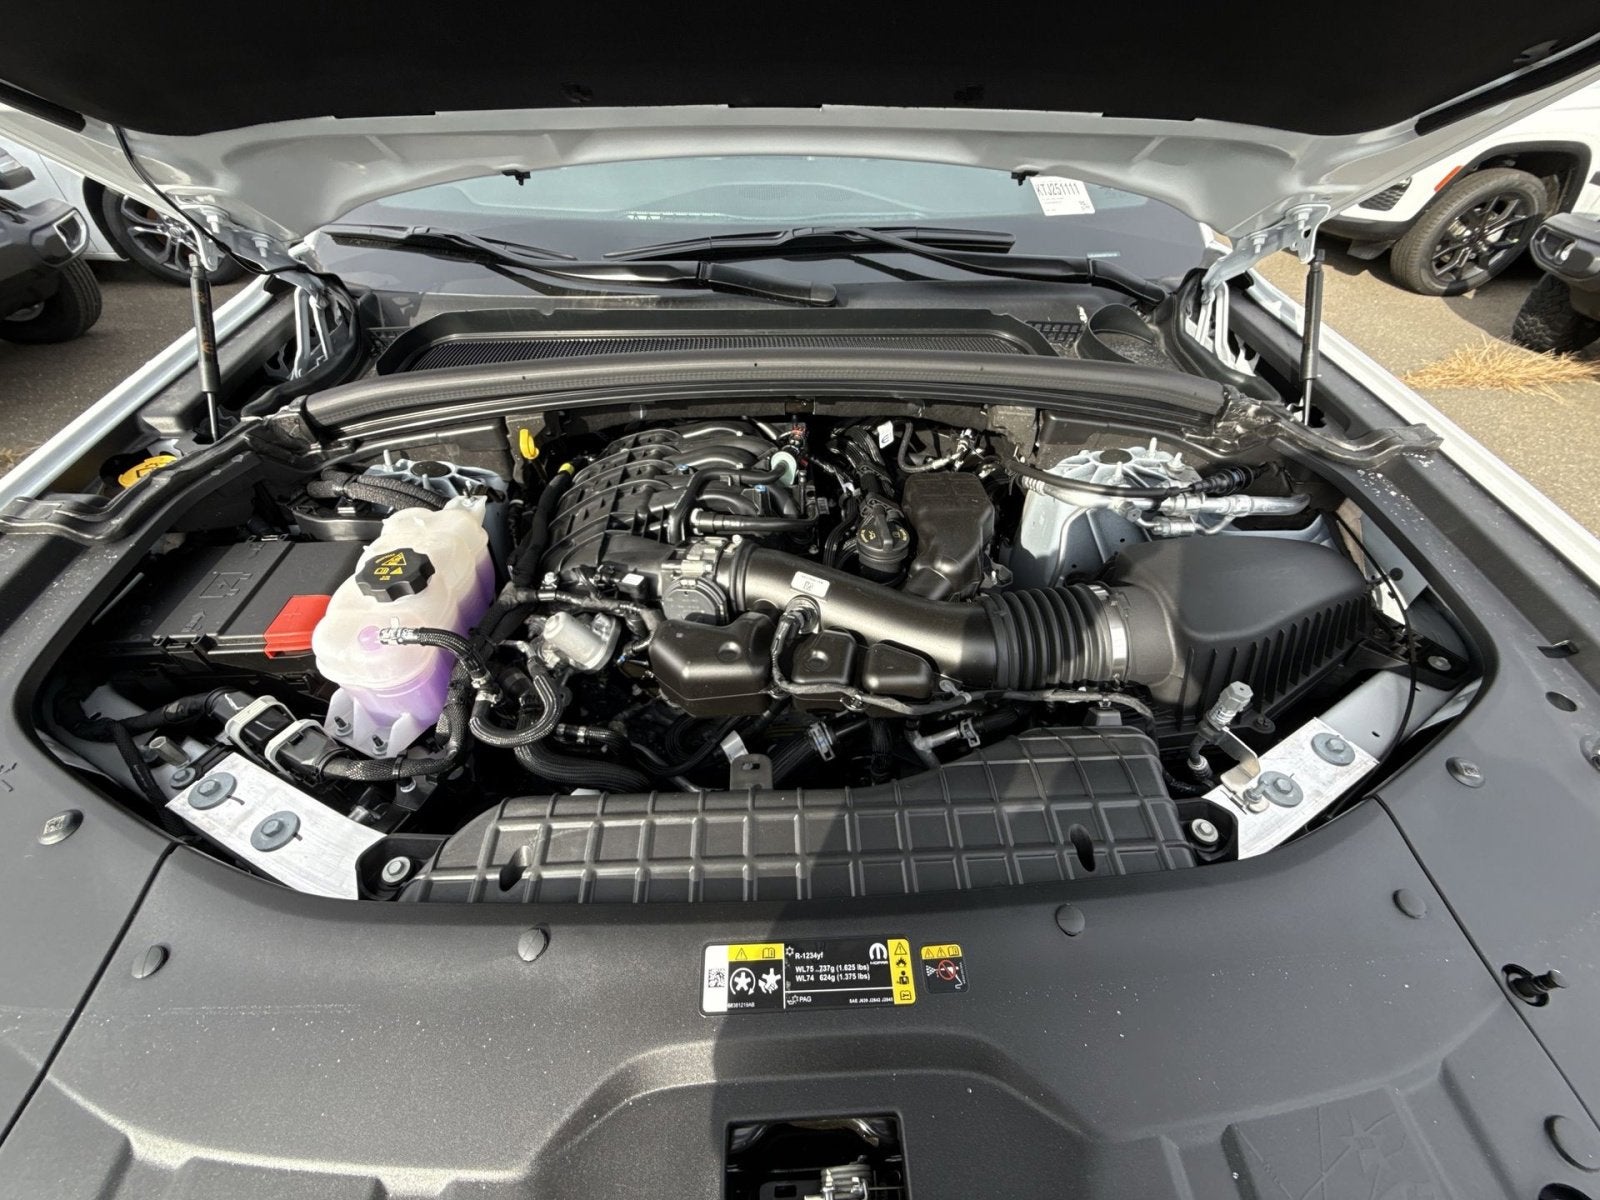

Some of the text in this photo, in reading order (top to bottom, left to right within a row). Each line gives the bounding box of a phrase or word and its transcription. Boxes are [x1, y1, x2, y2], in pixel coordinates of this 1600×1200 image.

[794, 951, 824, 960] R-1234yf
[795, 965, 815, 973] WL75
[836, 964, 856, 973] (1.625
[856, 963, 870, 972] lbs)
[795, 972, 871, 982] WL74 624g (1.375 lbs)
[799, 995, 812, 1003] PAG
